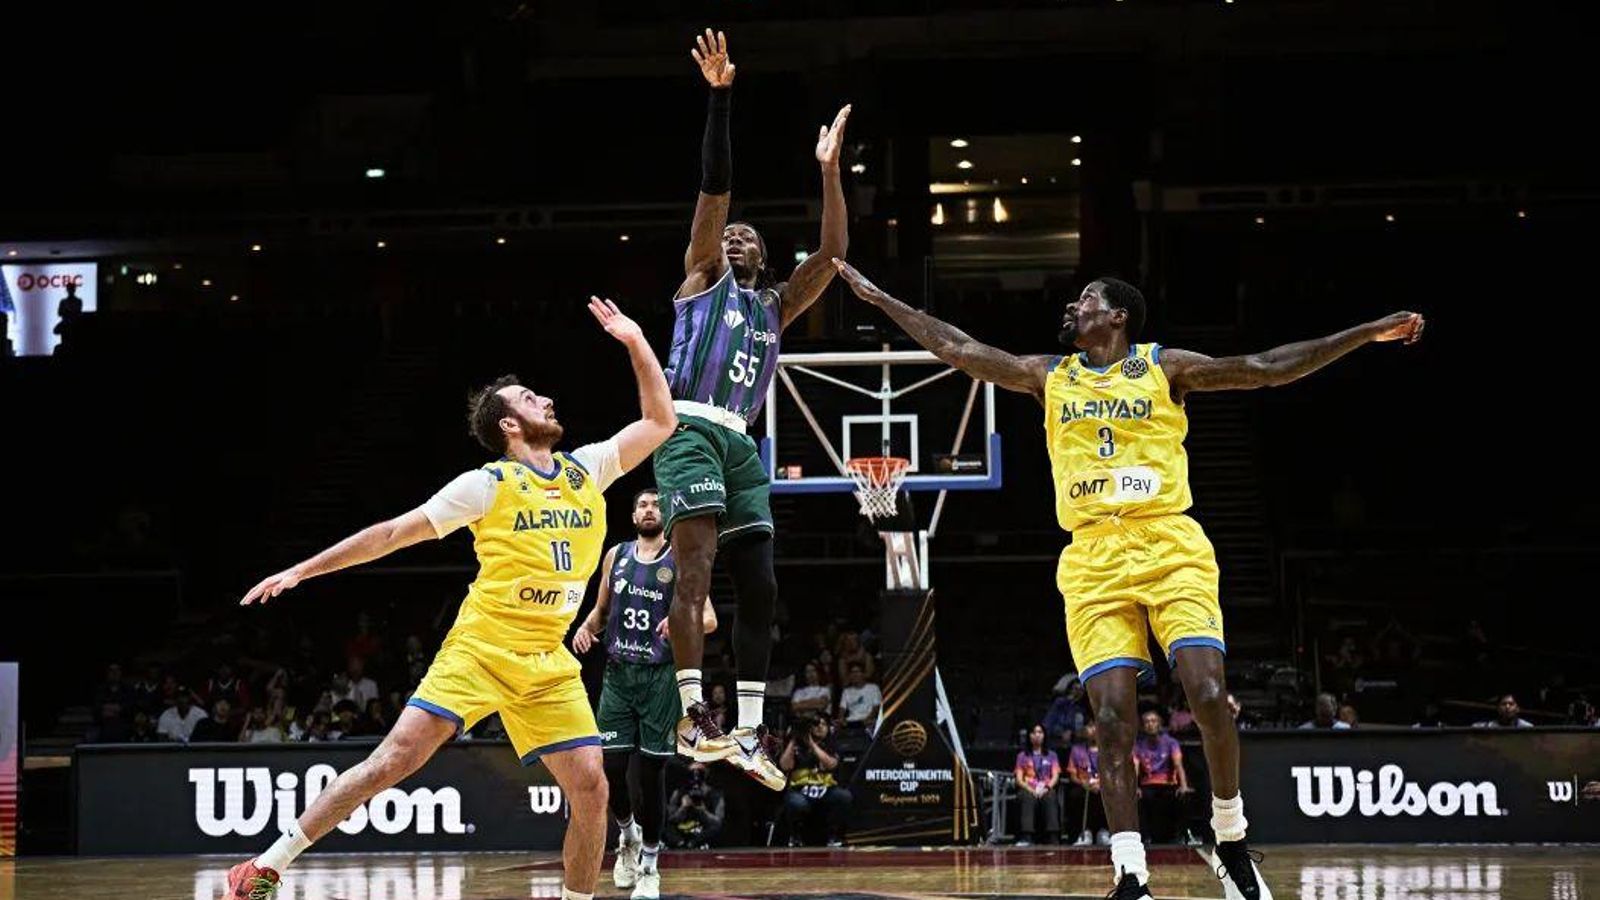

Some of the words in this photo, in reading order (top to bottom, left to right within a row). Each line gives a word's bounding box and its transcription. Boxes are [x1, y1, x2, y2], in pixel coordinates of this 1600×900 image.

[37, 274, 83, 289] OCBC
[728, 349, 760, 387] 55
[1061, 398, 1152, 424] ALRIYADI
[1098, 426, 1115, 459] 3
[1069, 478, 1109, 499] OMT
[1121, 476, 1152, 494] Pay
[551, 541, 572, 572] 16
[519, 586, 561, 605] OMT
[627, 584, 663, 602] Unicaja
[623, 607, 650, 631] 33
[865, 769, 954, 781] INTERCONTINENTAL
[900, 781, 919, 792] CUP
[1291, 764, 1502, 817] Wilson
